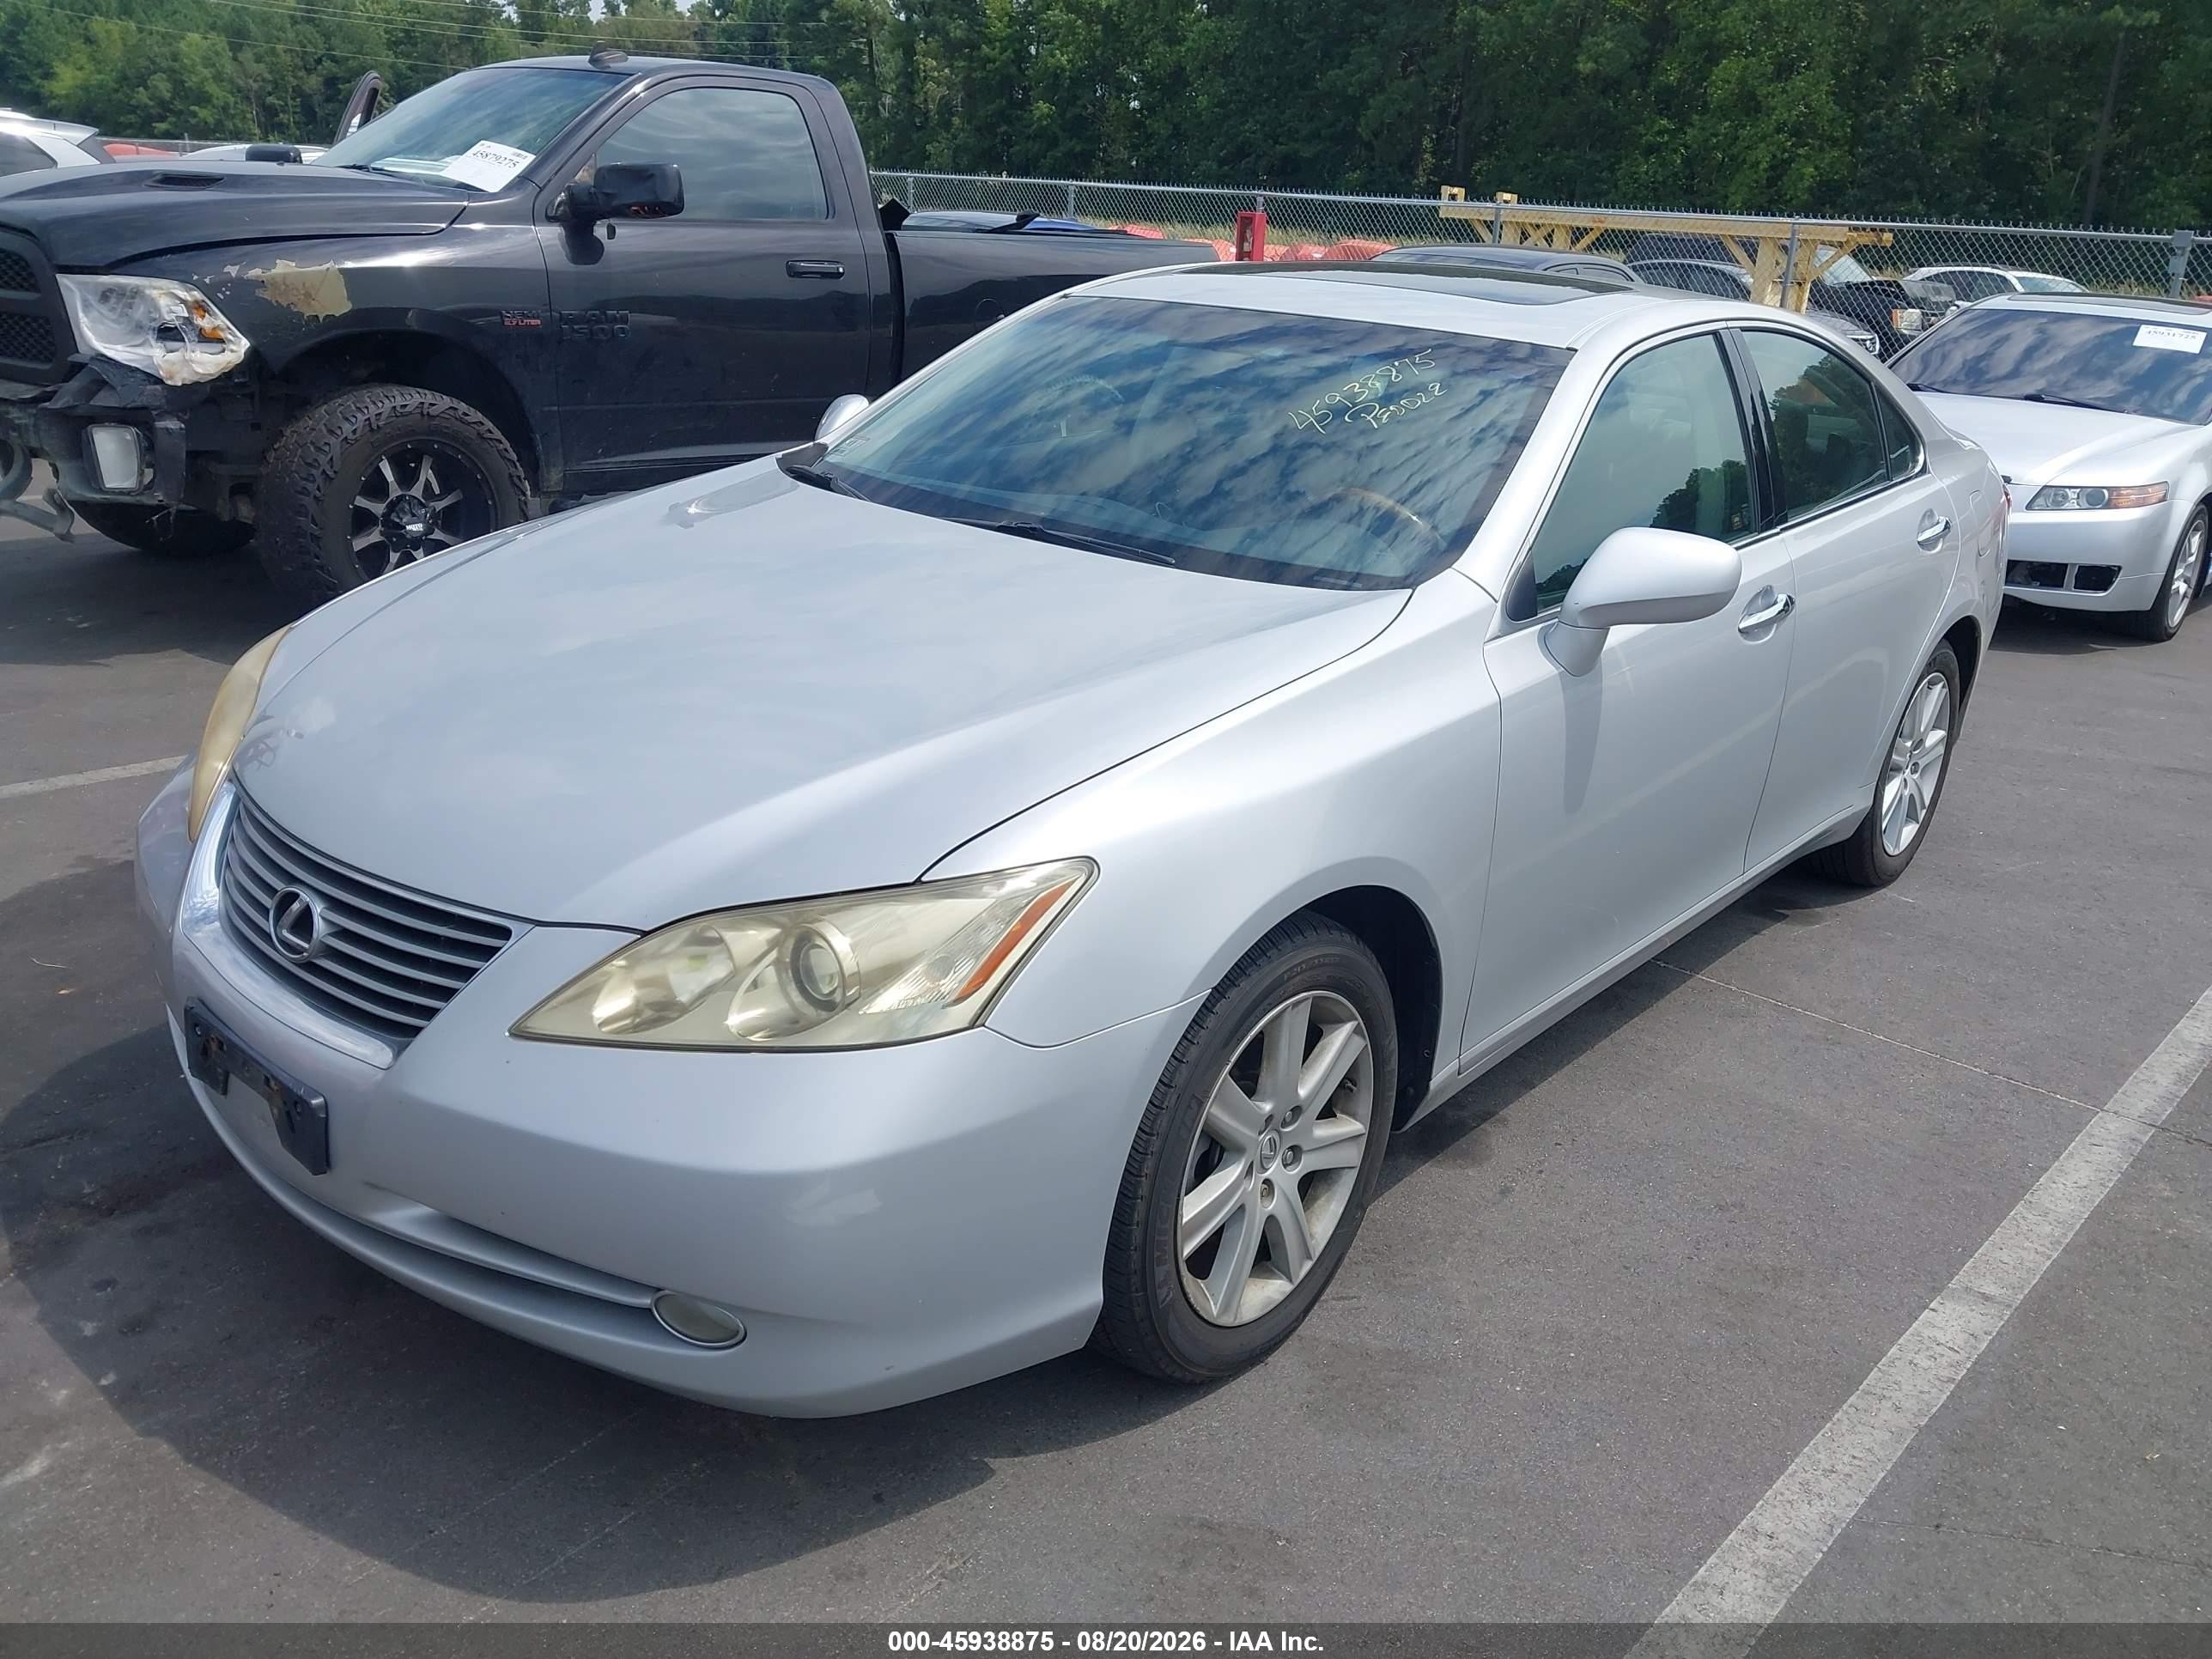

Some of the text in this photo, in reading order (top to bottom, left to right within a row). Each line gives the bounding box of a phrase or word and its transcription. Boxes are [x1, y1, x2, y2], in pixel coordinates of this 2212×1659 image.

[472, 149, 520, 168] 45879275
[560, 311, 630, 325] RAM
[561, 325, 632, 340] 1500
[1288, 348, 1436, 434] 45938875
